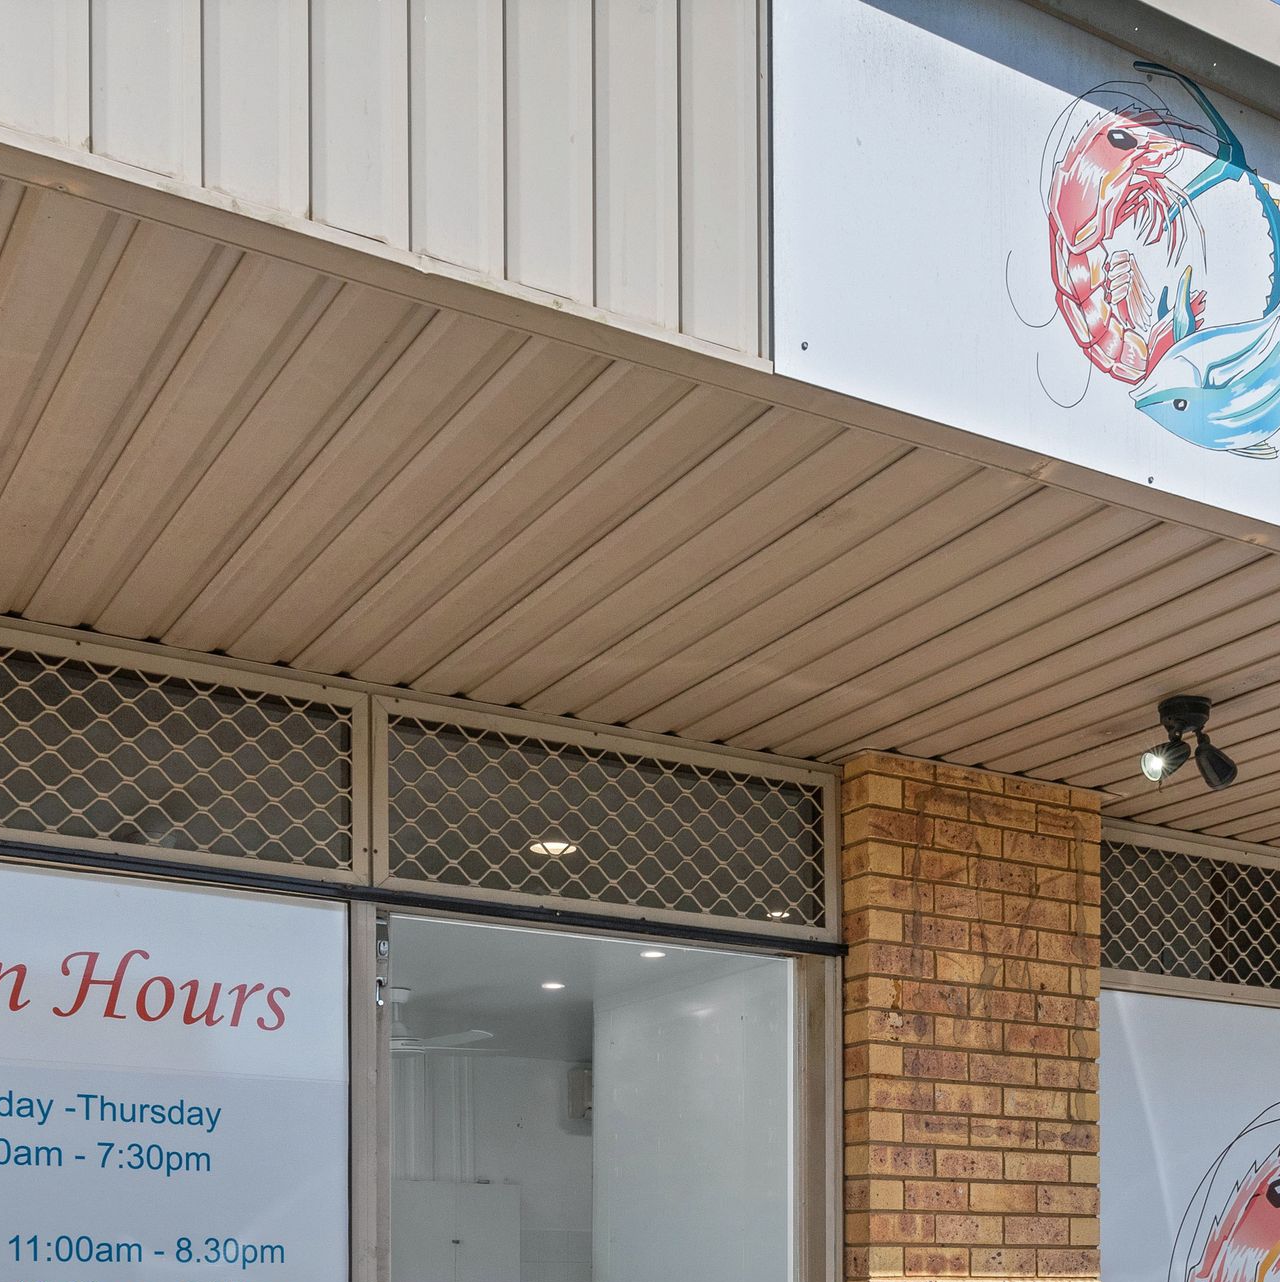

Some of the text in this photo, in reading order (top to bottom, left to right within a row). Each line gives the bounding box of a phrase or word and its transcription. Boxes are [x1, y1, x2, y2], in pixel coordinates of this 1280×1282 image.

[52, 949, 291, 1032] Hours
[95, 1142, 213, 1177] 7:30pm
[7, 1234, 144, 1264] 11:00am
[175, 1236, 287, 1269] 8.30pm
